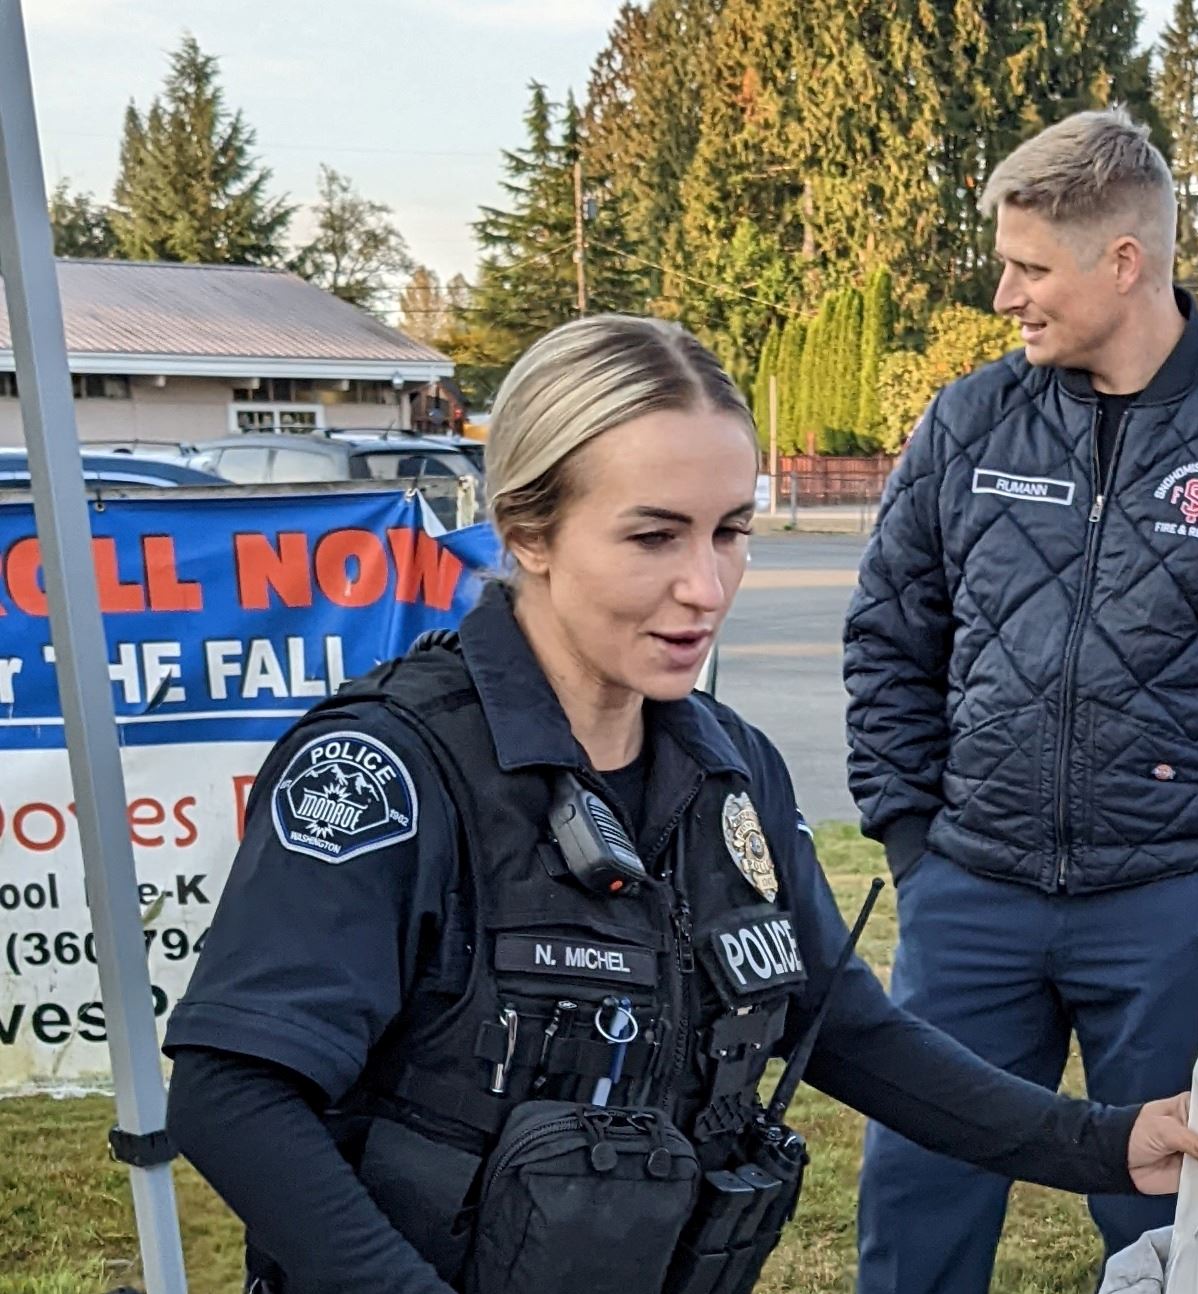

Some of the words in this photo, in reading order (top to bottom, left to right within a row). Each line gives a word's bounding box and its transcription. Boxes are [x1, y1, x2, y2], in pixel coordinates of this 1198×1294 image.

[995, 478, 1048, 496] RUMANN
[1154, 522, 1178, 534] FIRE
[235, 526, 463, 611] NOW
[310, 742, 397, 785] POLICE
[297, 792, 364, 831] MONROE
[289, 831, 342, 855] WASHINGTON
[534, 944, 557, 966] N.
[564, 946, 631, 973] MICHEL
[719, 919, 803, 985] POLICE
